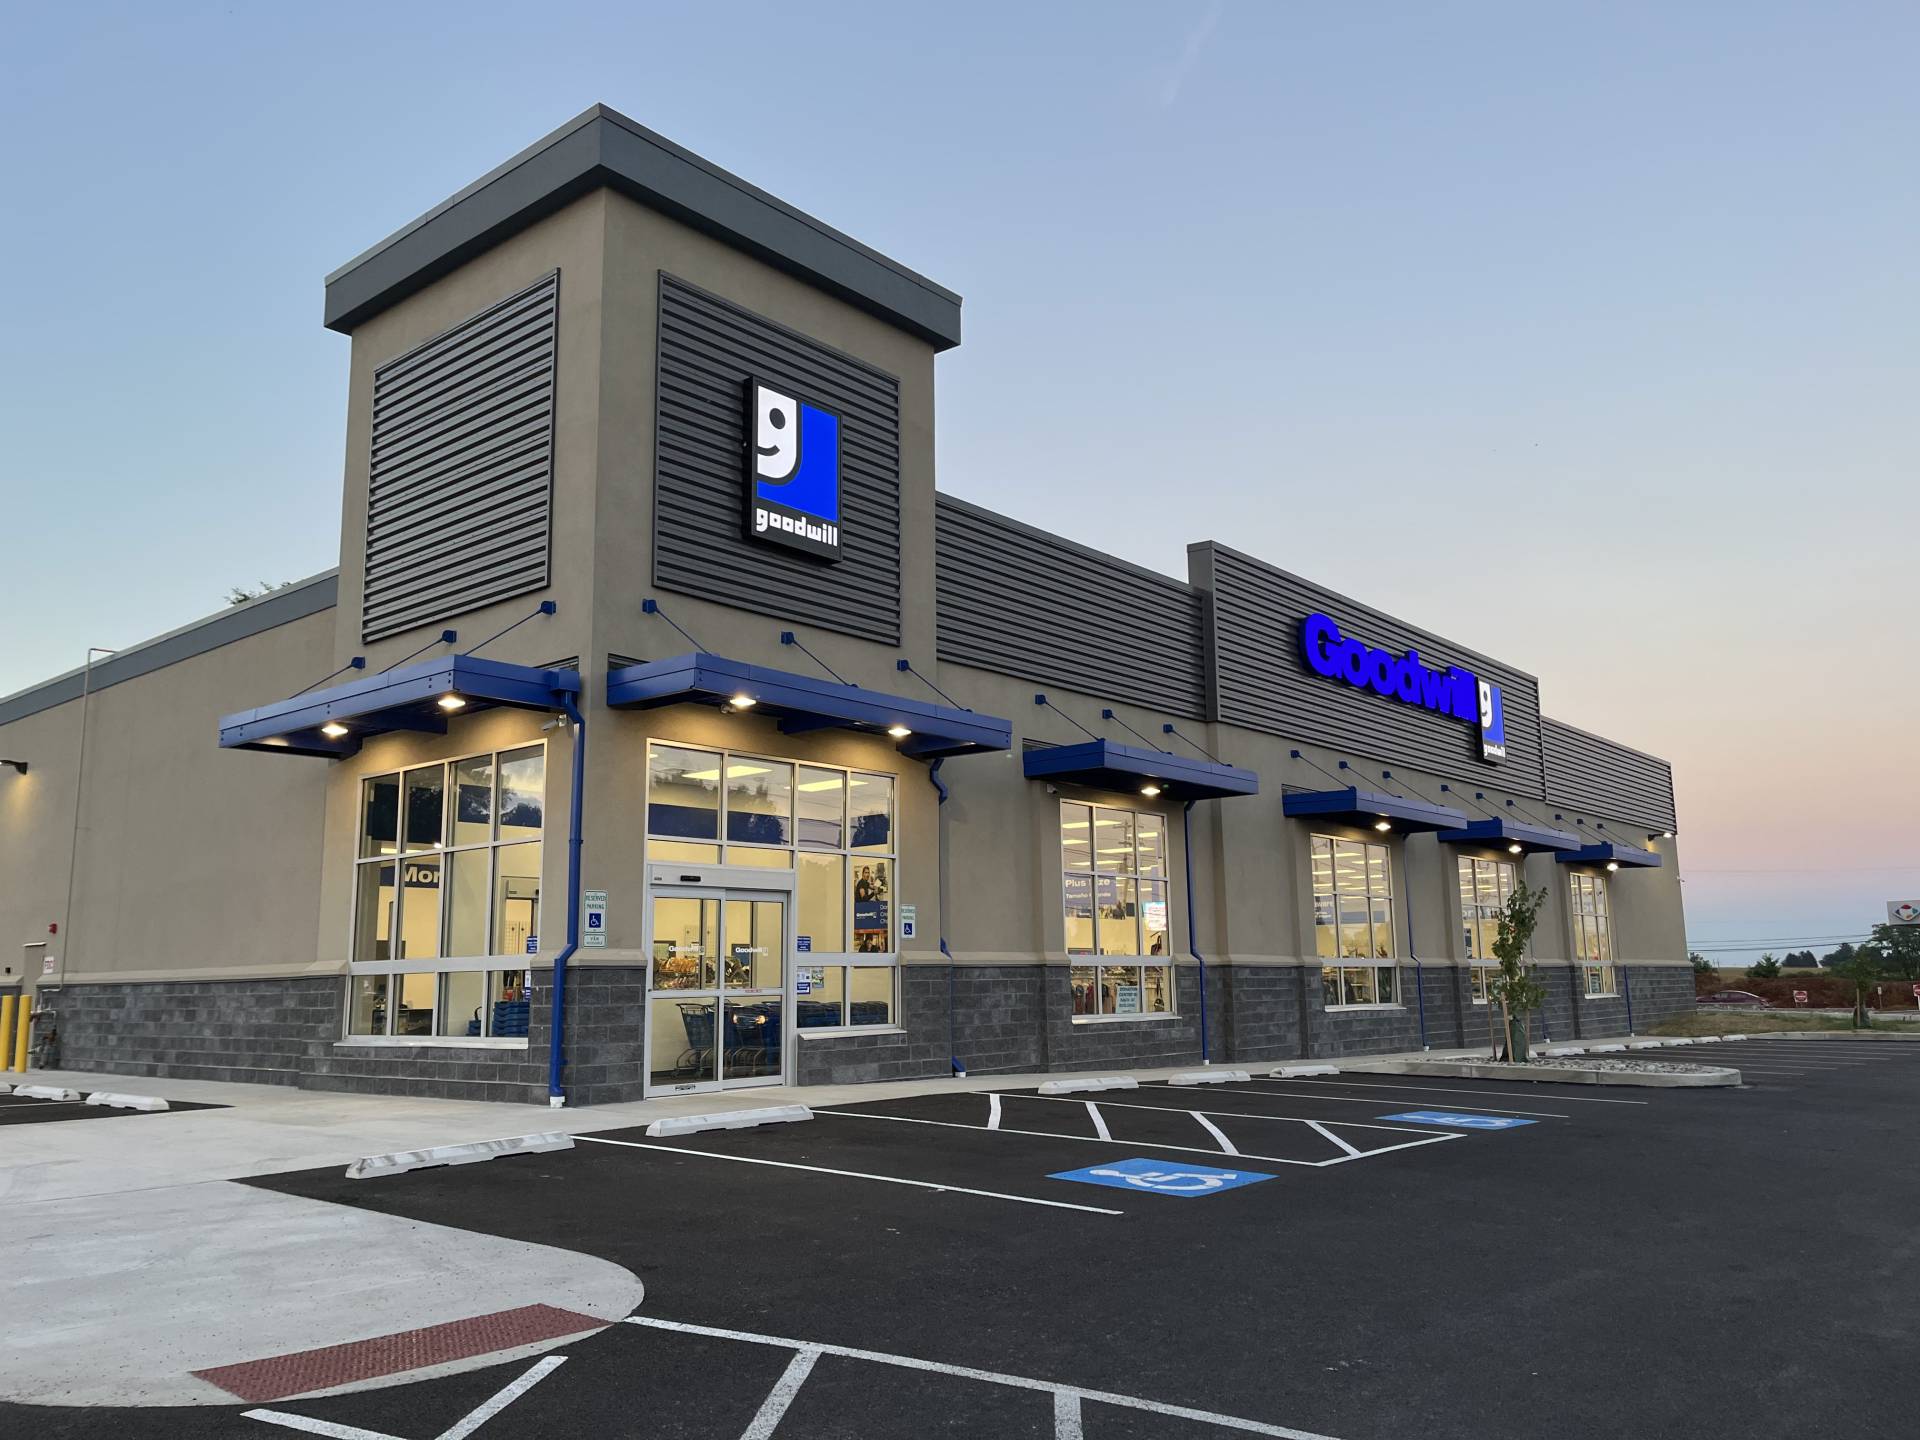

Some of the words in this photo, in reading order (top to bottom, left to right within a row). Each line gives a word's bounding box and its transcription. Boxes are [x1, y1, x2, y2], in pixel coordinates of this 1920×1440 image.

[756, 507, 838, 547] goodwill
[1304, 612, 1479, 724] Goodwill
[1065, 879, 1087, 888] Plus
